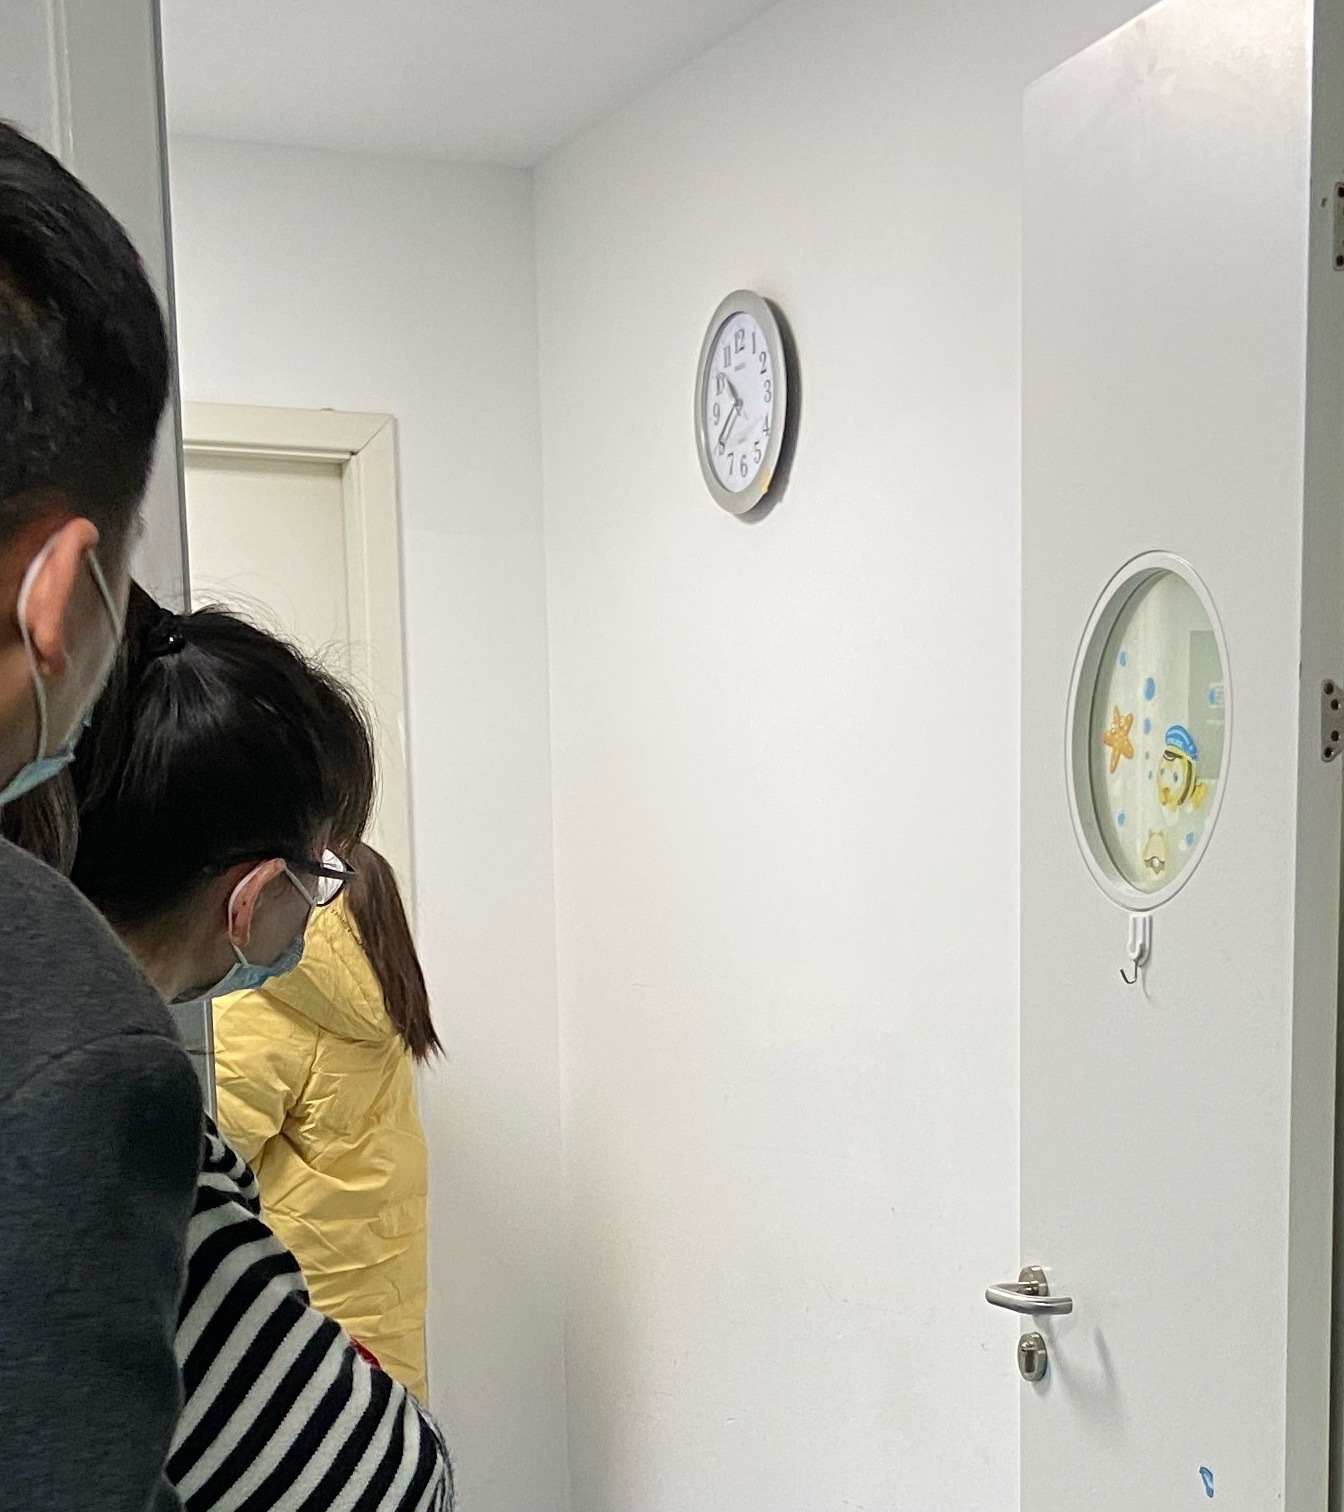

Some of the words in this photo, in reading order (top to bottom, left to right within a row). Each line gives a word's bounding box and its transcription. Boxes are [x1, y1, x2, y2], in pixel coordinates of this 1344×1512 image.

[734, 328, 745, 354] 12
[751, 331, 756, 355] 1
[758, 351, 767, 375] 2
[763, 379, 772, 403] 3
[712, 402, 721, 426] 9
[762, 414, 770, 437] 4
[727, 452, 735, 475] 7
[753, 440, 762, 464] 5
[740, 454, 748, 478] 6
